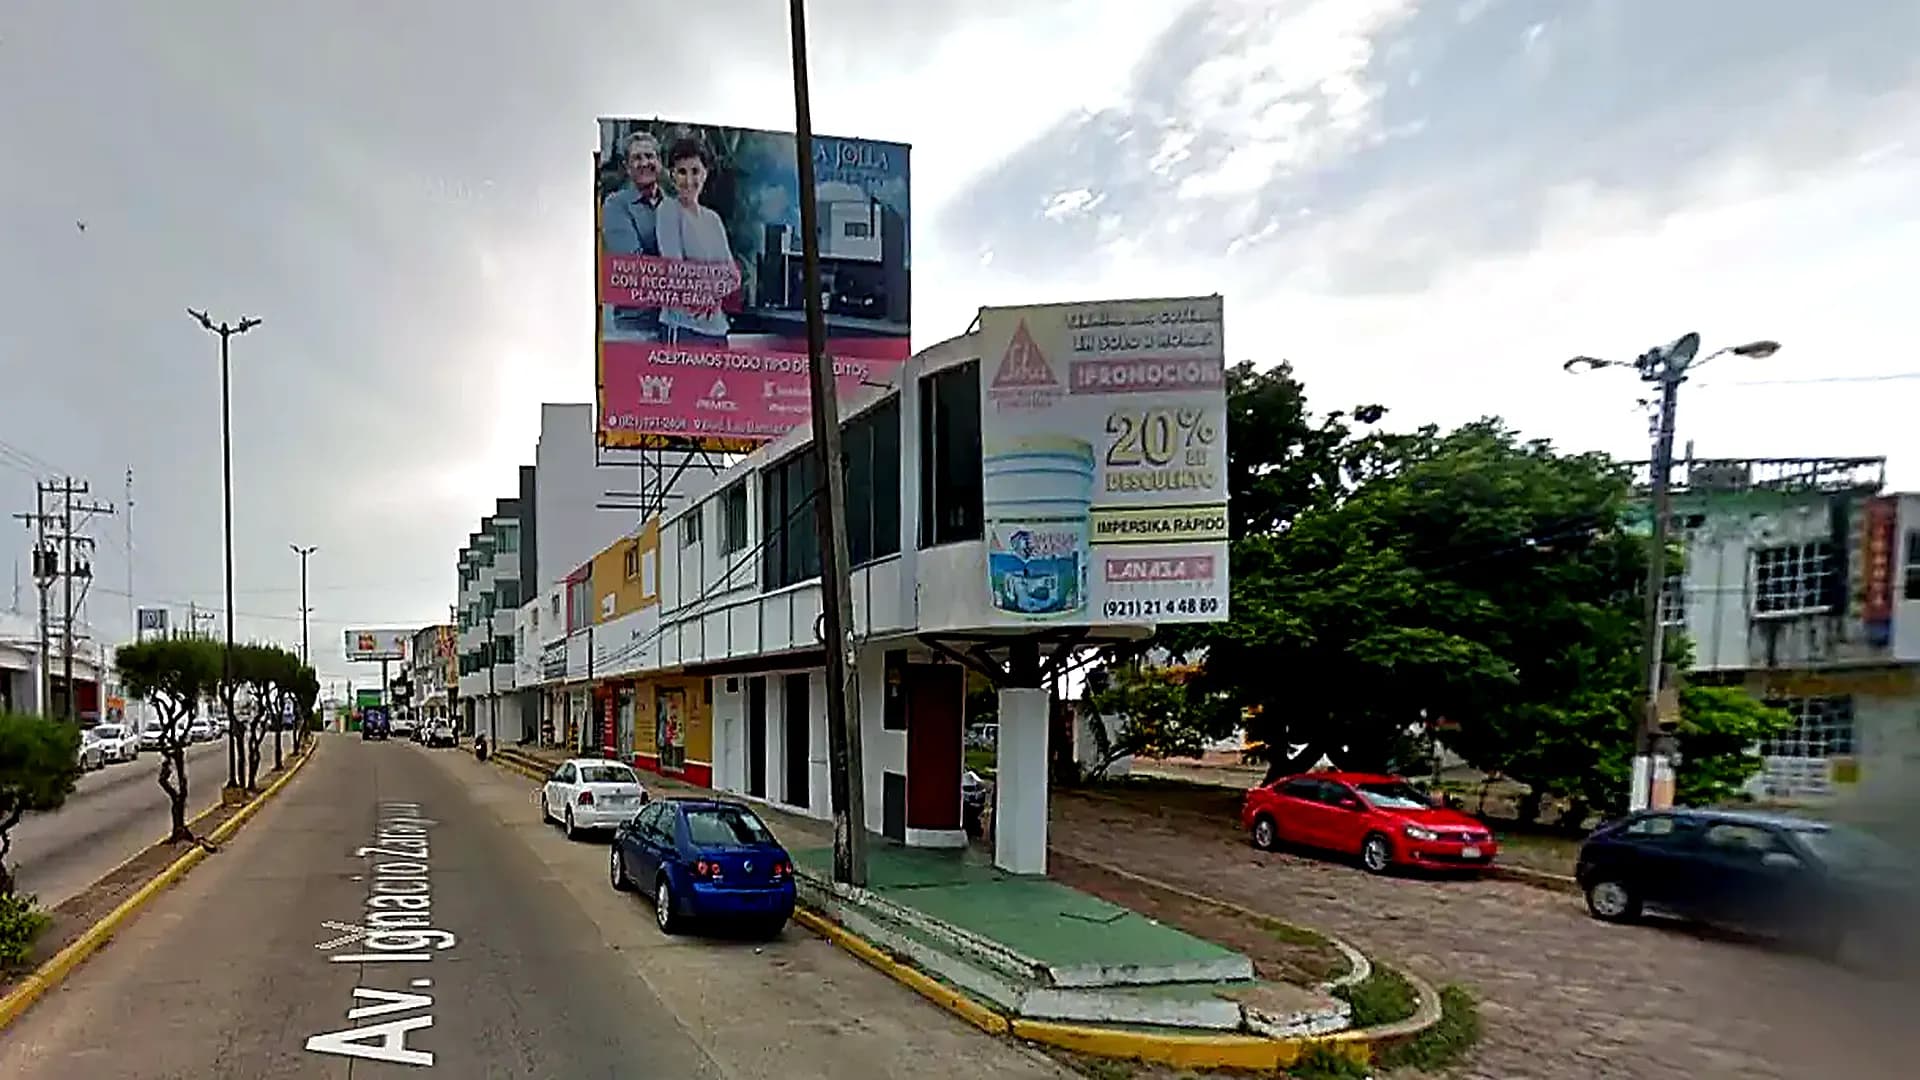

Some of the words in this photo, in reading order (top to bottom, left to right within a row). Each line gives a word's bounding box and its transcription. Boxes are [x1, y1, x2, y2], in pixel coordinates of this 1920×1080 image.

[835, 142, 888, 171] JOLLA
[610, 273, 638, 288] CON
[630, 288, 680, 305] PLANTA
[648, 350, 722, 367] ACEPTAMOS
[723, 354, 762, 371] TODO
[764, 357, 792, 373] TIPO
[1106, 408, 1217, 466] 20%
[1097, 519, 1171, 533] IMPERSIKA
[1103, 600, 1141, 616] (921)
[1144, 601, 1160, 614] 21
[1166, 600, 1175, 613] 4
